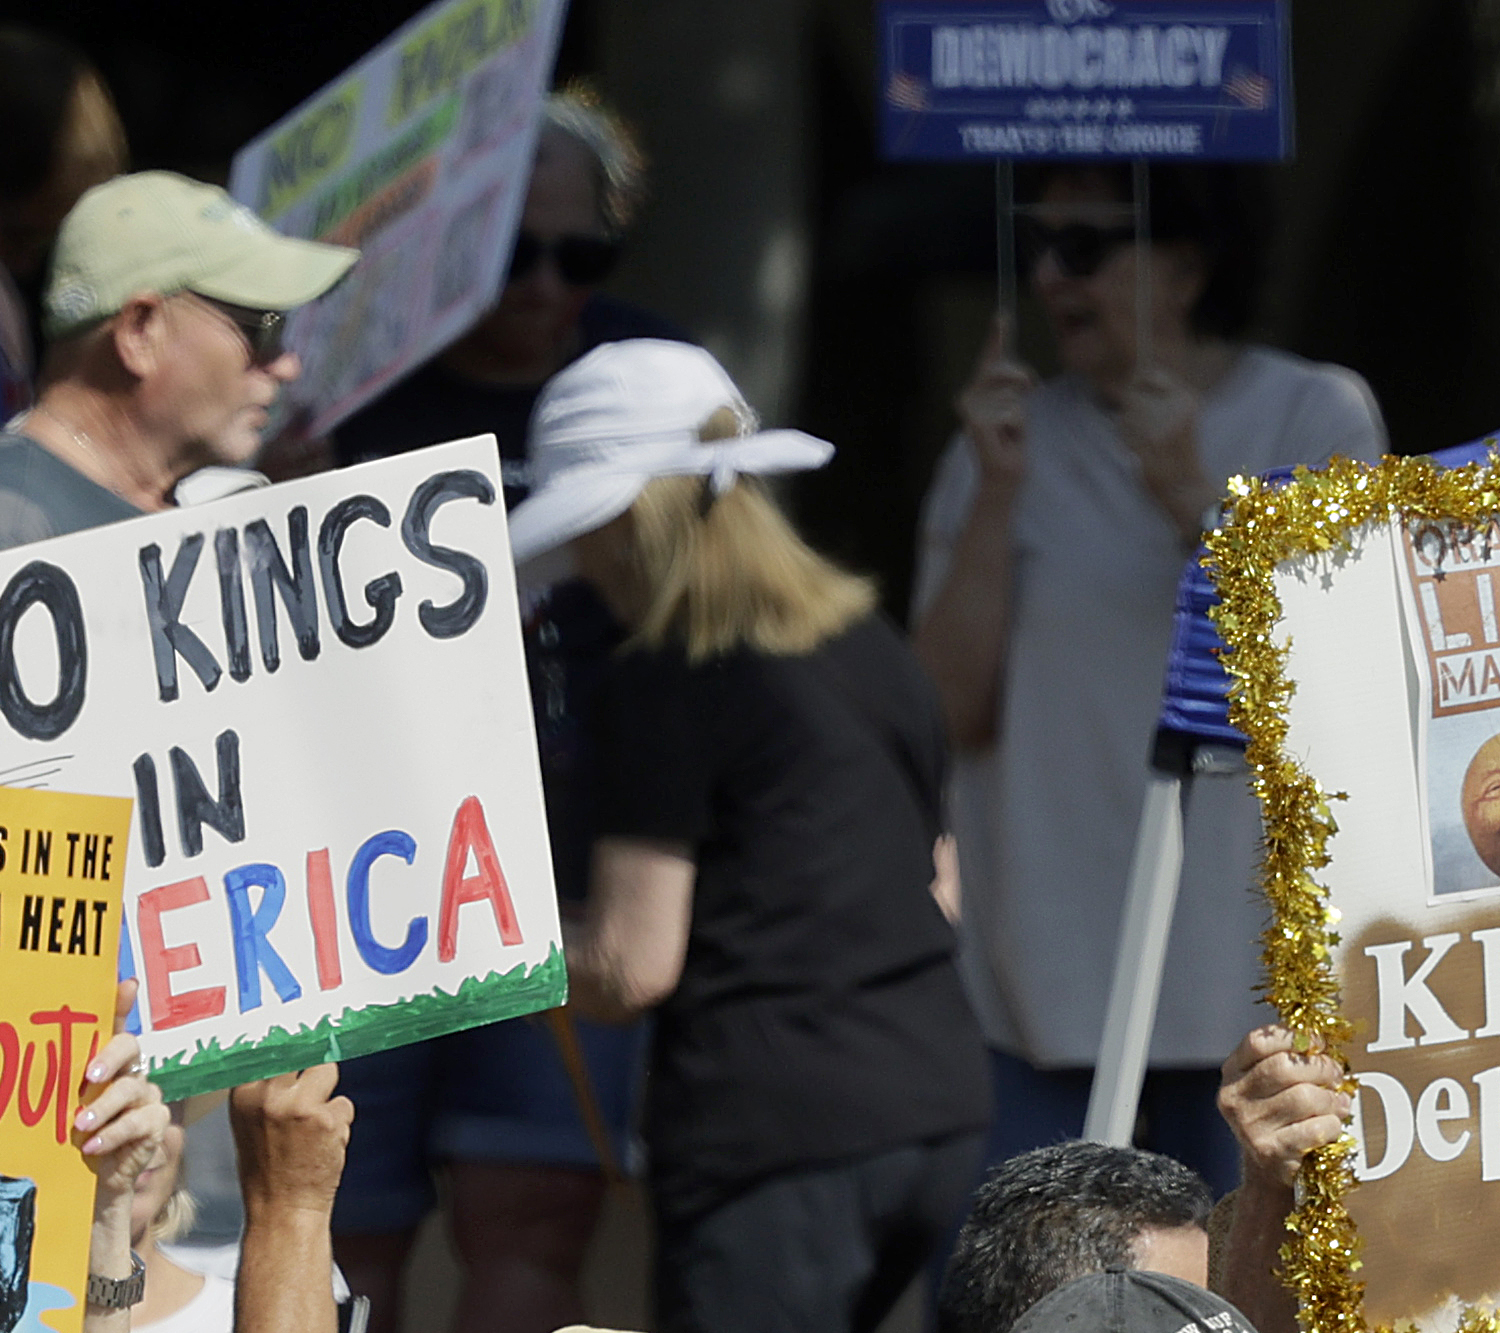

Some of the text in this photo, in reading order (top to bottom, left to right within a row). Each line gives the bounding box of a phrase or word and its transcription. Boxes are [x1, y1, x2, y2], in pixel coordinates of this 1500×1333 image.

[932, 25, 1230, 89] DEMOCRACY
[138, 468, 497, 704] KINGS
[131, 728, 247, 869] IN
[20, 830, 51, 877] IN
[65, 833, 113, 881] THE
[19, 896, 108, 957] HEAT
[118, 794, 523, 1036] ERICA
